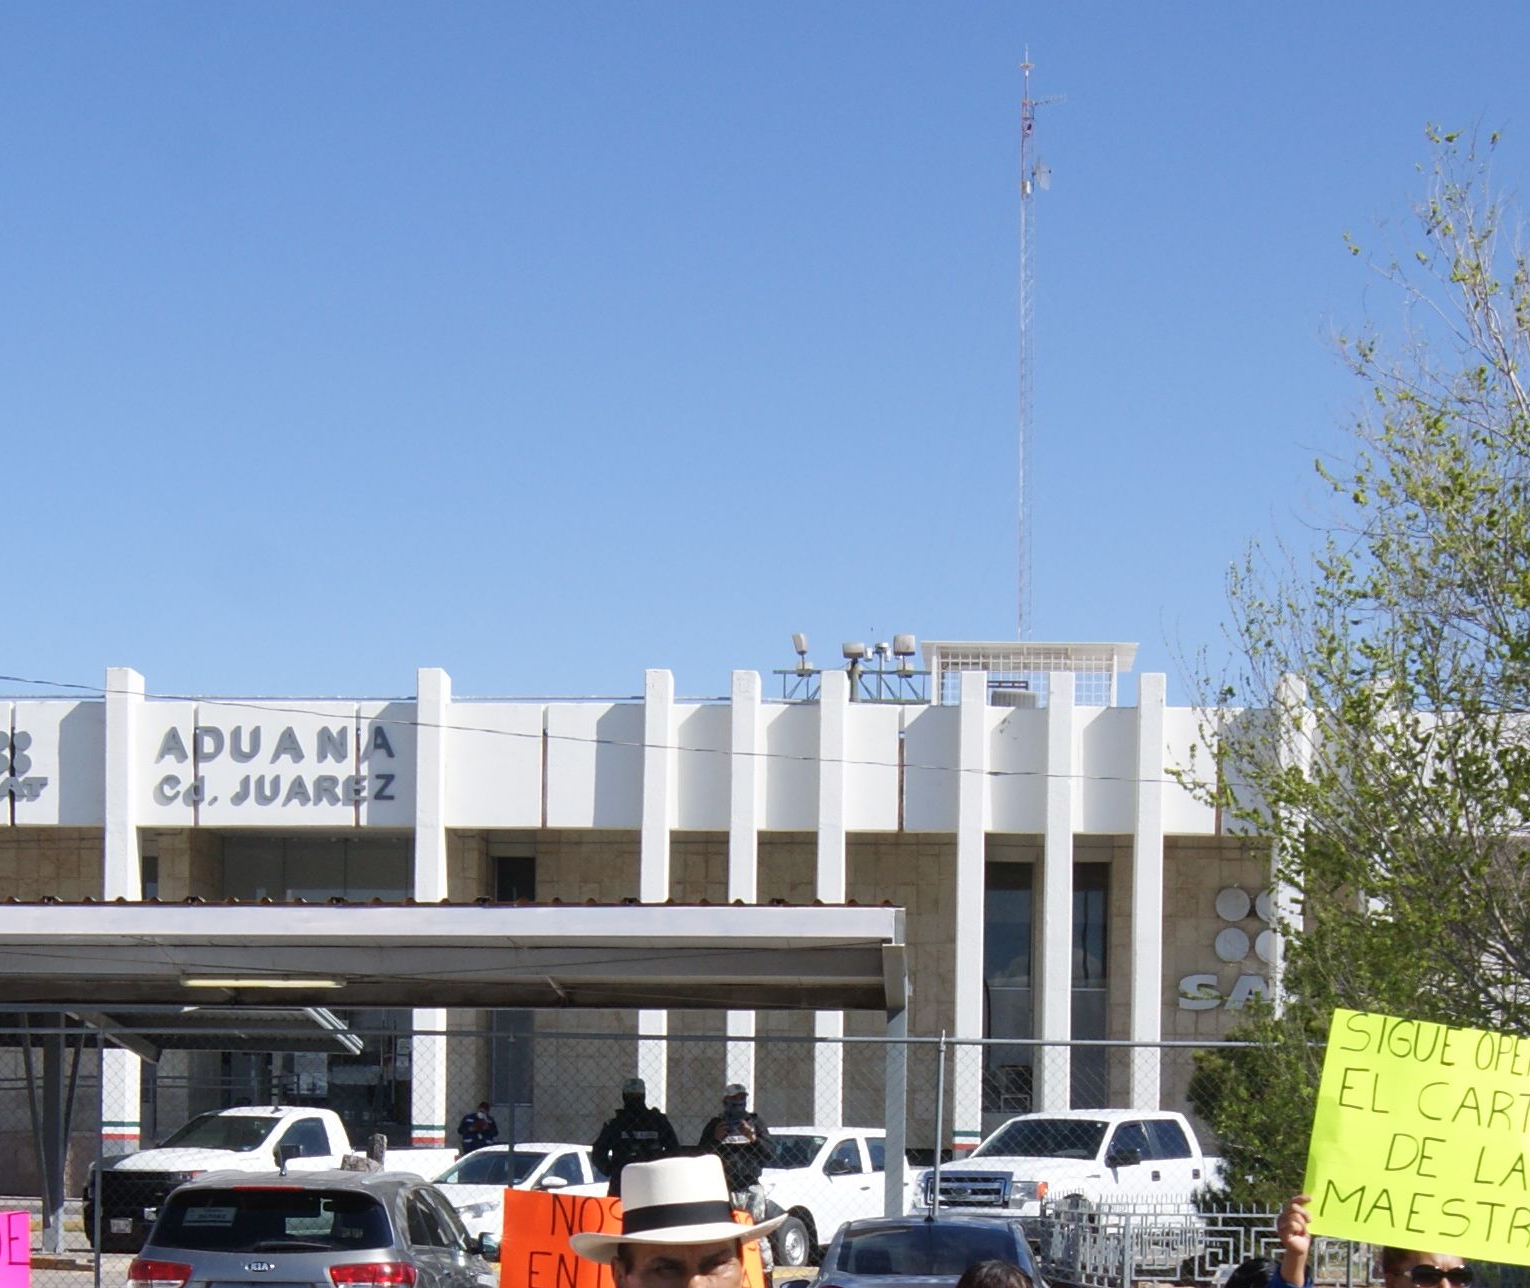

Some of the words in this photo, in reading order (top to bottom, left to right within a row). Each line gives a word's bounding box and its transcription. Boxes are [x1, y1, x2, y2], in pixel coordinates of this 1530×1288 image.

[154, 725, 396, 765] ADUANA
[231, 774, 396, 807] JUAREZ
[1179, 974, 1270, 1010] SA
[1340, 1012, 1463, 1067] SIGUE
[1339, 1067, 1390, 1114] EL
[1385, 1133, 1447, 1179] DE
[1474, 1146, 1528, 1192] LA
